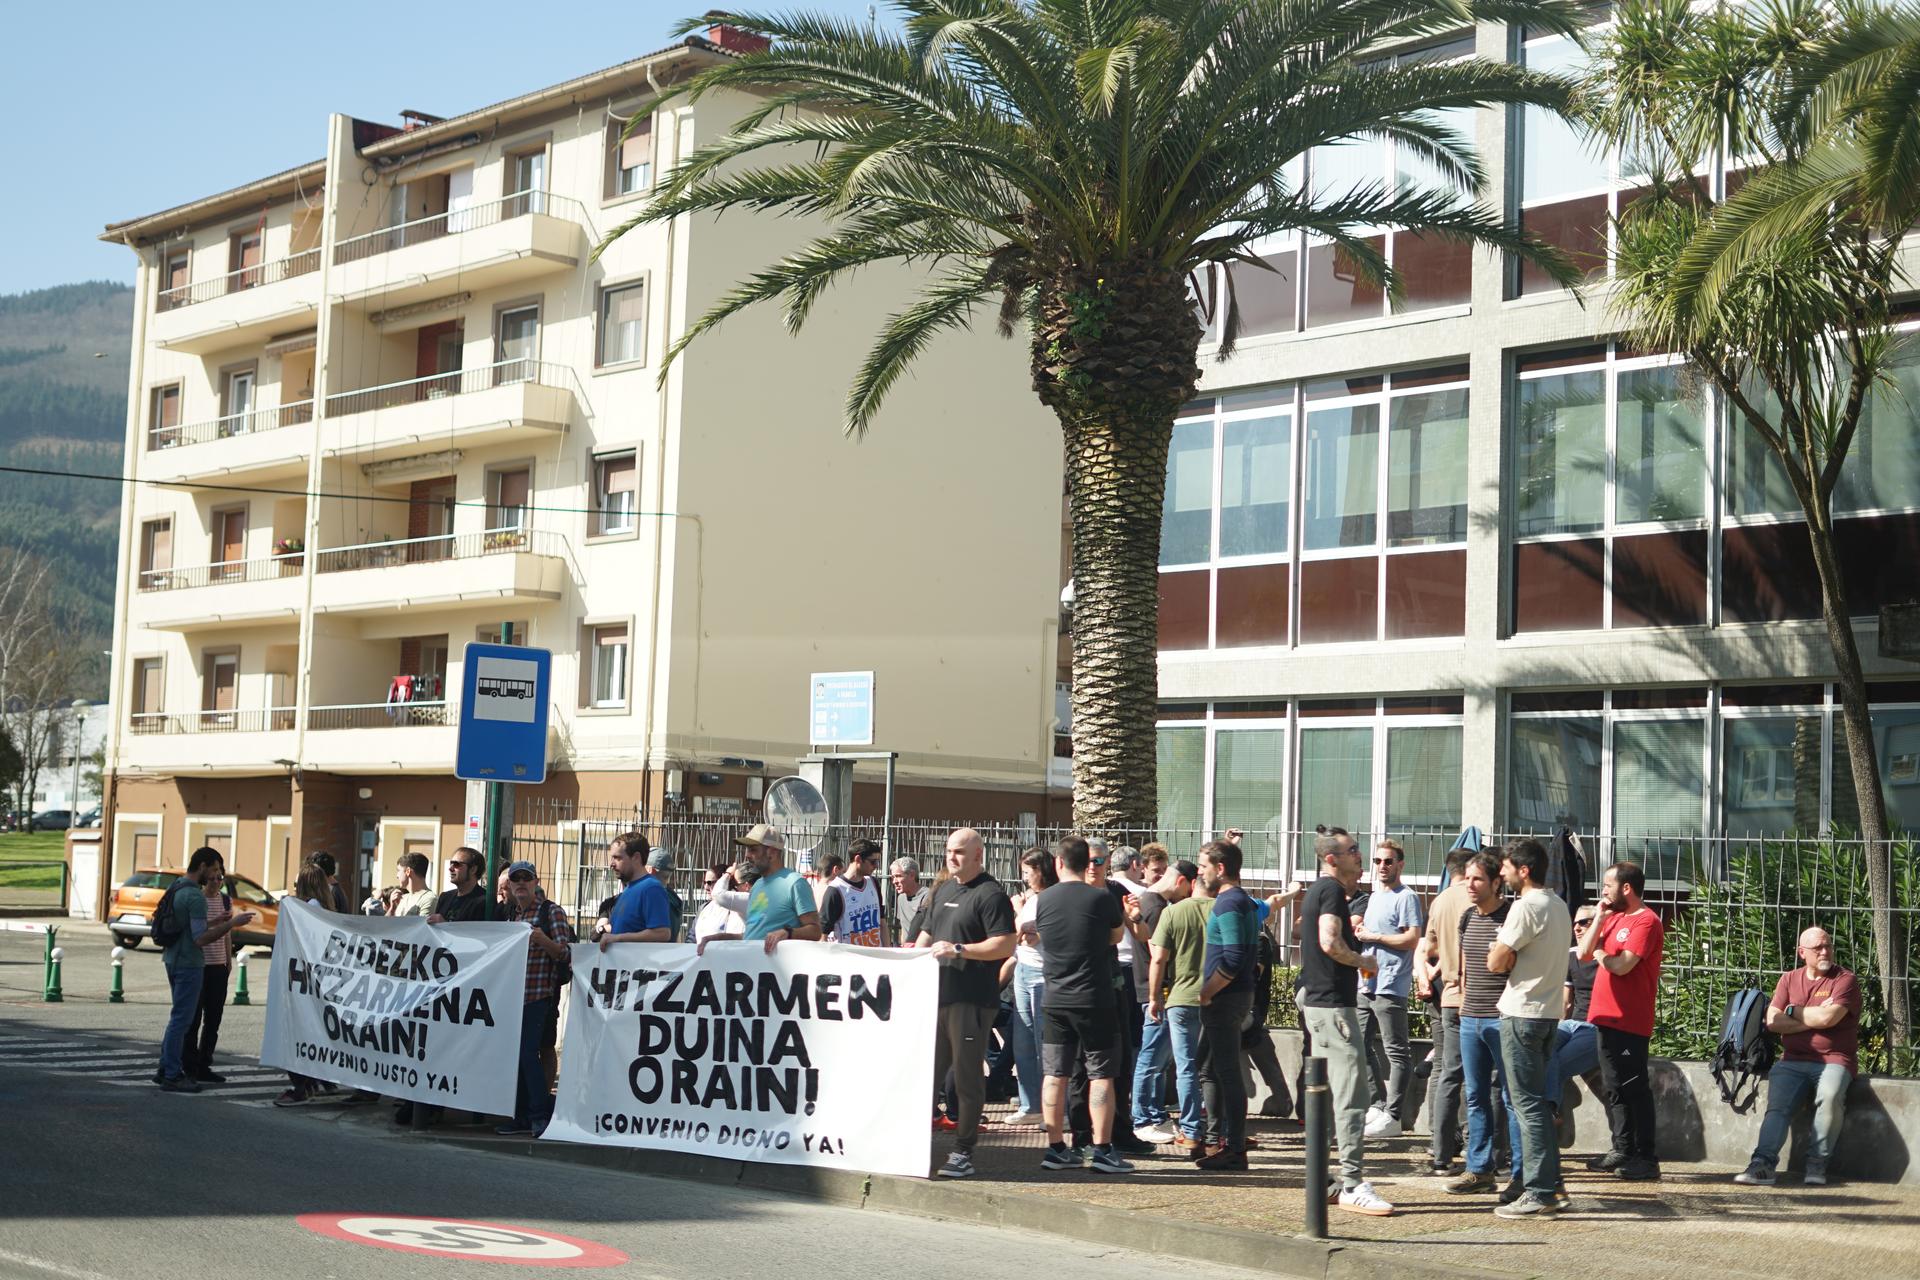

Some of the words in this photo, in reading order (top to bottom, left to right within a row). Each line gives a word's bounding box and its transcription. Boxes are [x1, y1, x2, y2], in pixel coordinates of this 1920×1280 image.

[321, 929, 459, 984] BIDEZKO
[288, 957, 495, 1027] HITZARMENA
[322, 1005, 429, 1062] ORAIN!
[637, 1014, 811, 1067] DUINA
[373, 1063, 418, 1088] JUSTO
[426, 1072, 459, 1095] YA!
[628, 1055, 819, 1117] ORAIN!
[716, 1126, 791, 1151] DIGNO
[802, 1134, 845, 1156] YA!
